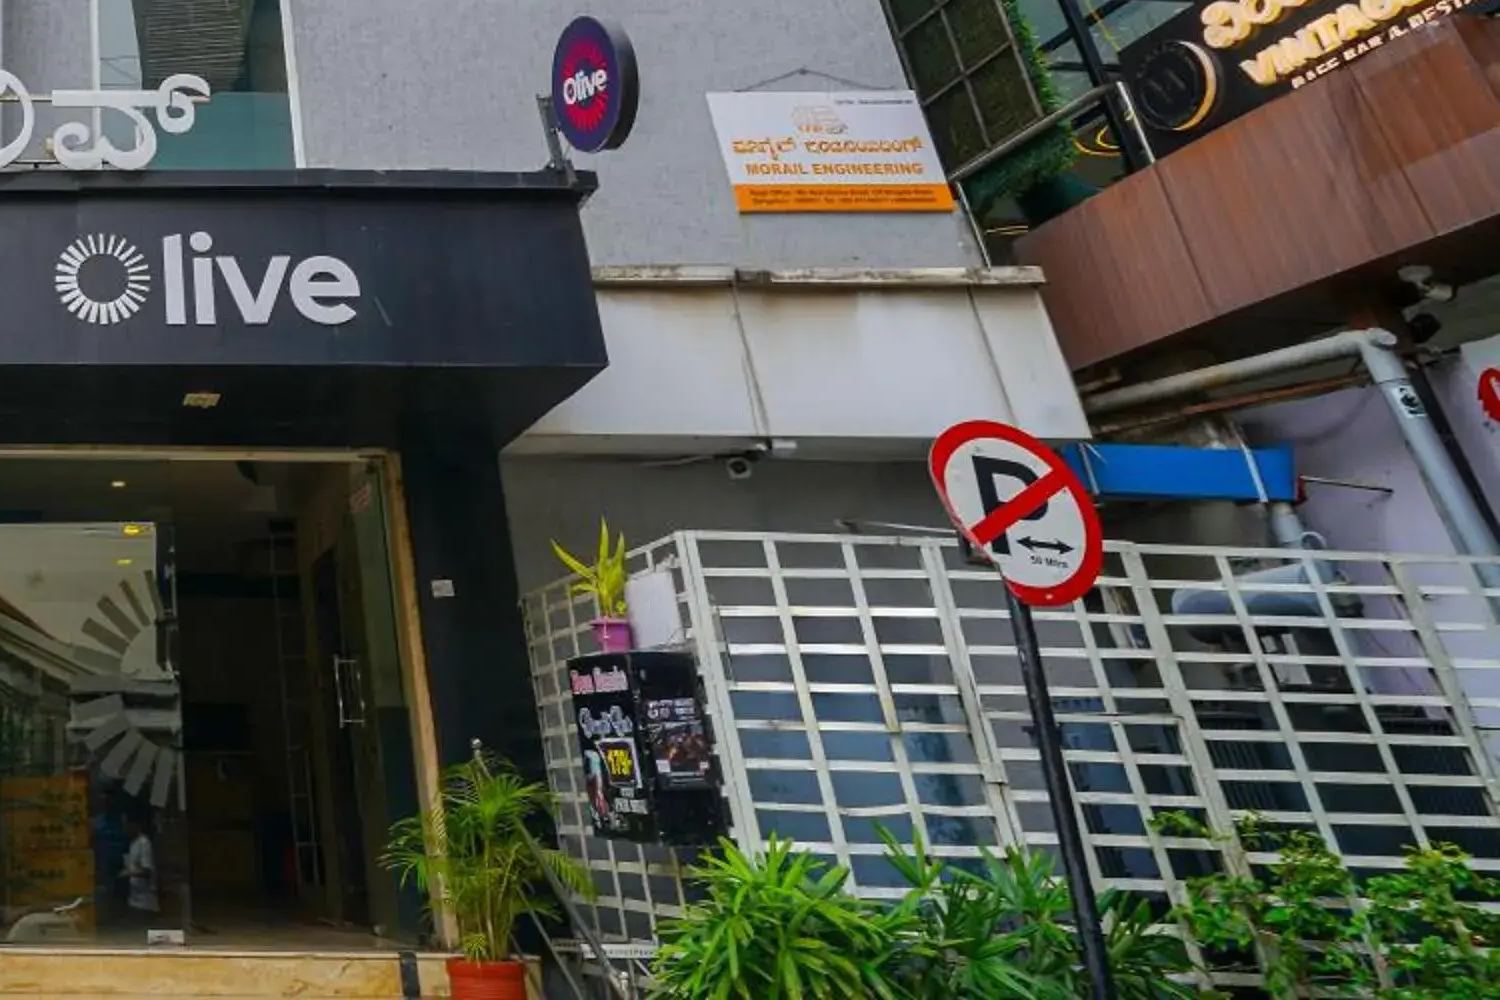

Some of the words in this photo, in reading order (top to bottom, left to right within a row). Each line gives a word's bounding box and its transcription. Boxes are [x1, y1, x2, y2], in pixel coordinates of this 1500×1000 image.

[563, 68, 607, 105] Olive
[745, 163, 808, 176] MORAIL
[812, 163, 924, 176] ENGINEERING
